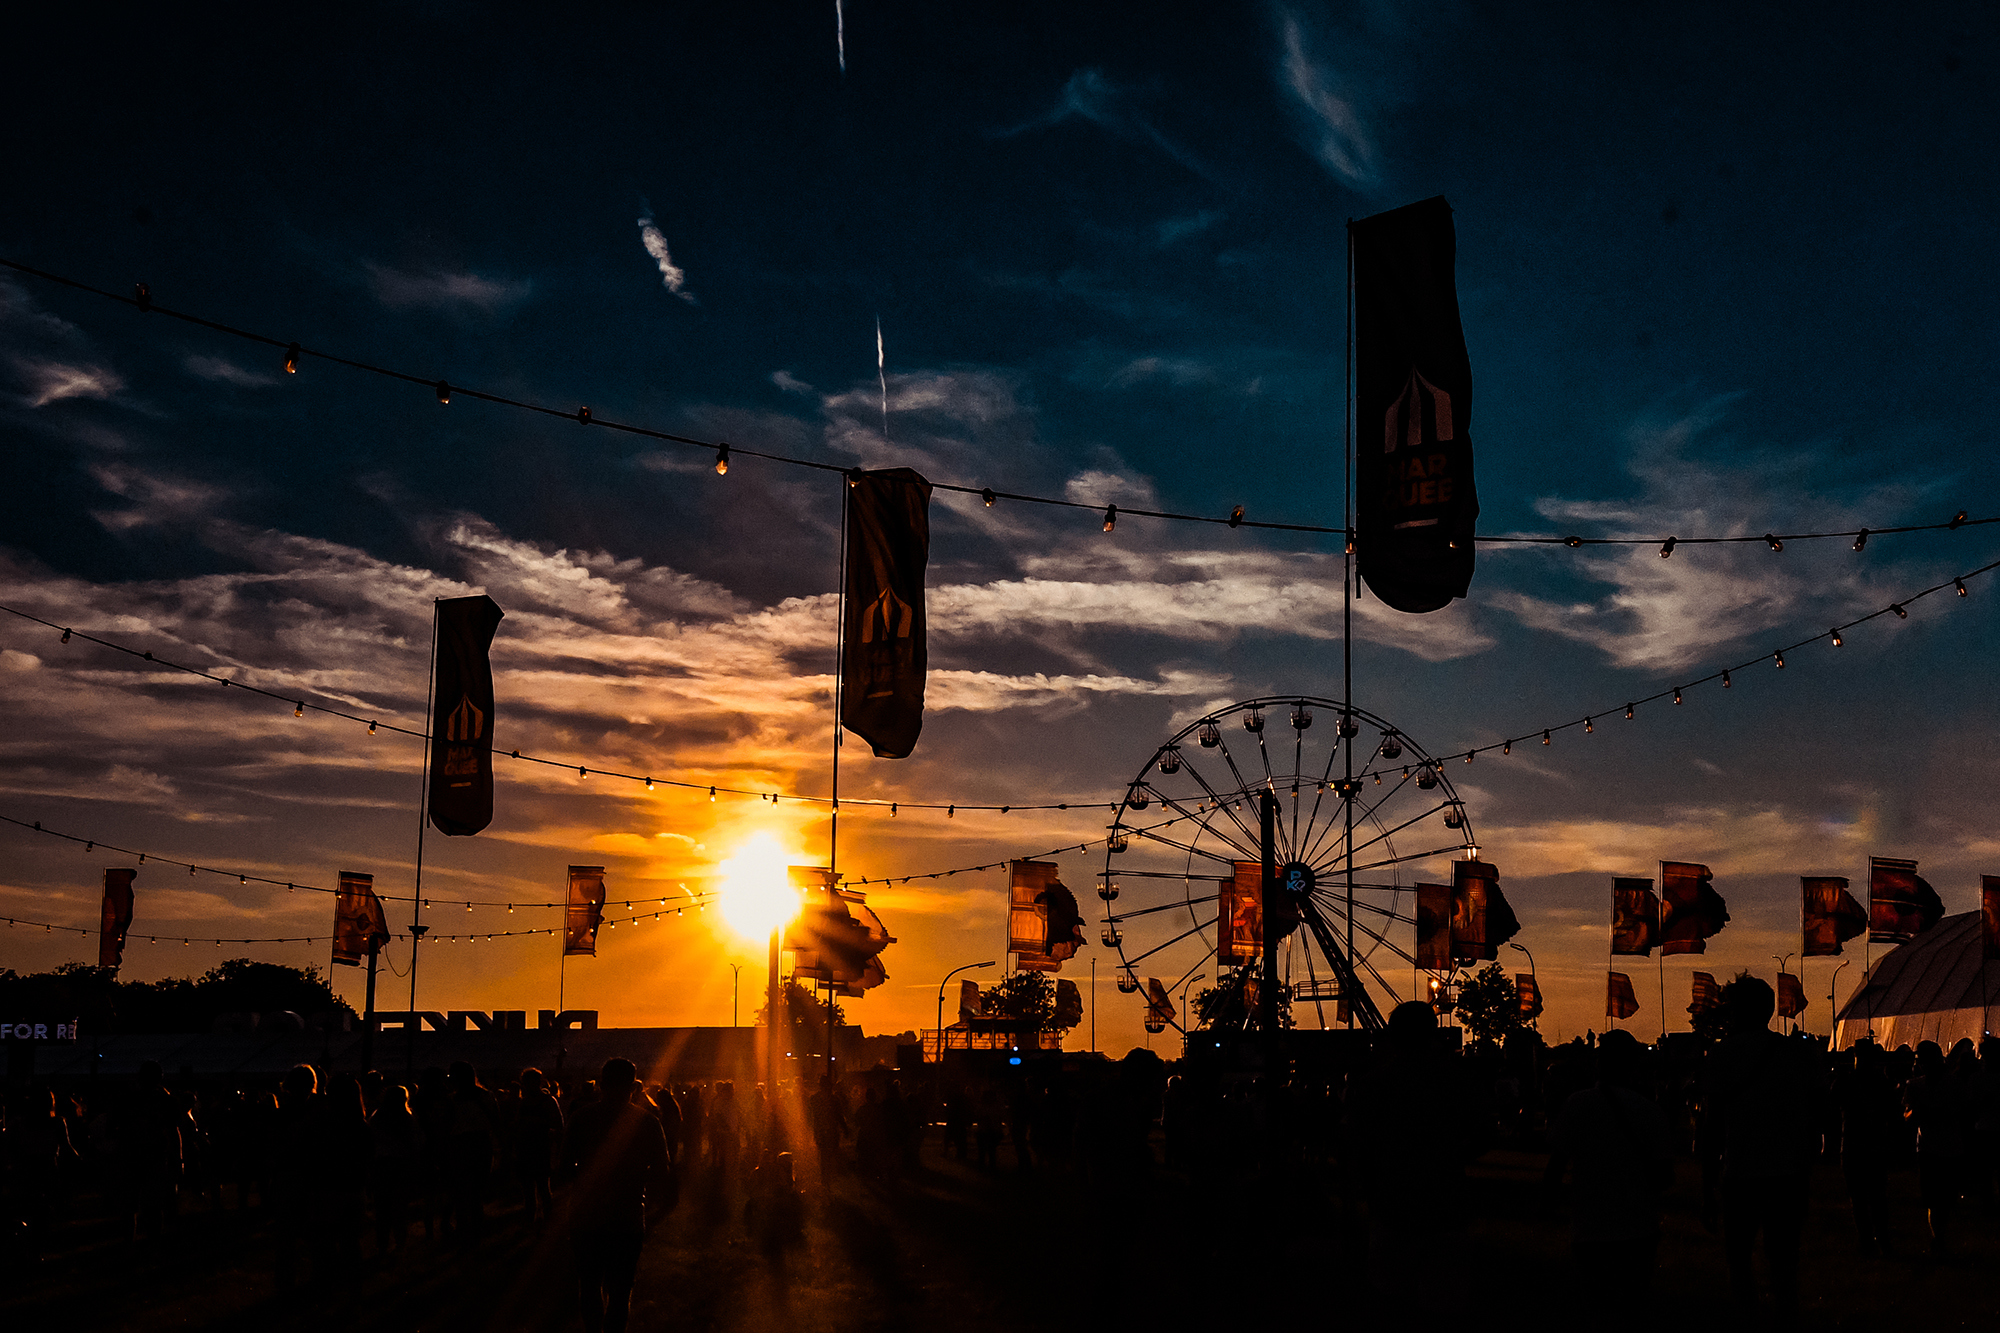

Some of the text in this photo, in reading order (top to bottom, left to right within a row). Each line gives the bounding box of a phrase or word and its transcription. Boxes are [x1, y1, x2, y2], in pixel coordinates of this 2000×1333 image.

[1386, 453, 1448, 486] MAR
[1381, 477, 1454, 511] QUEE
[0, 1023, 48, 1039] FOR
